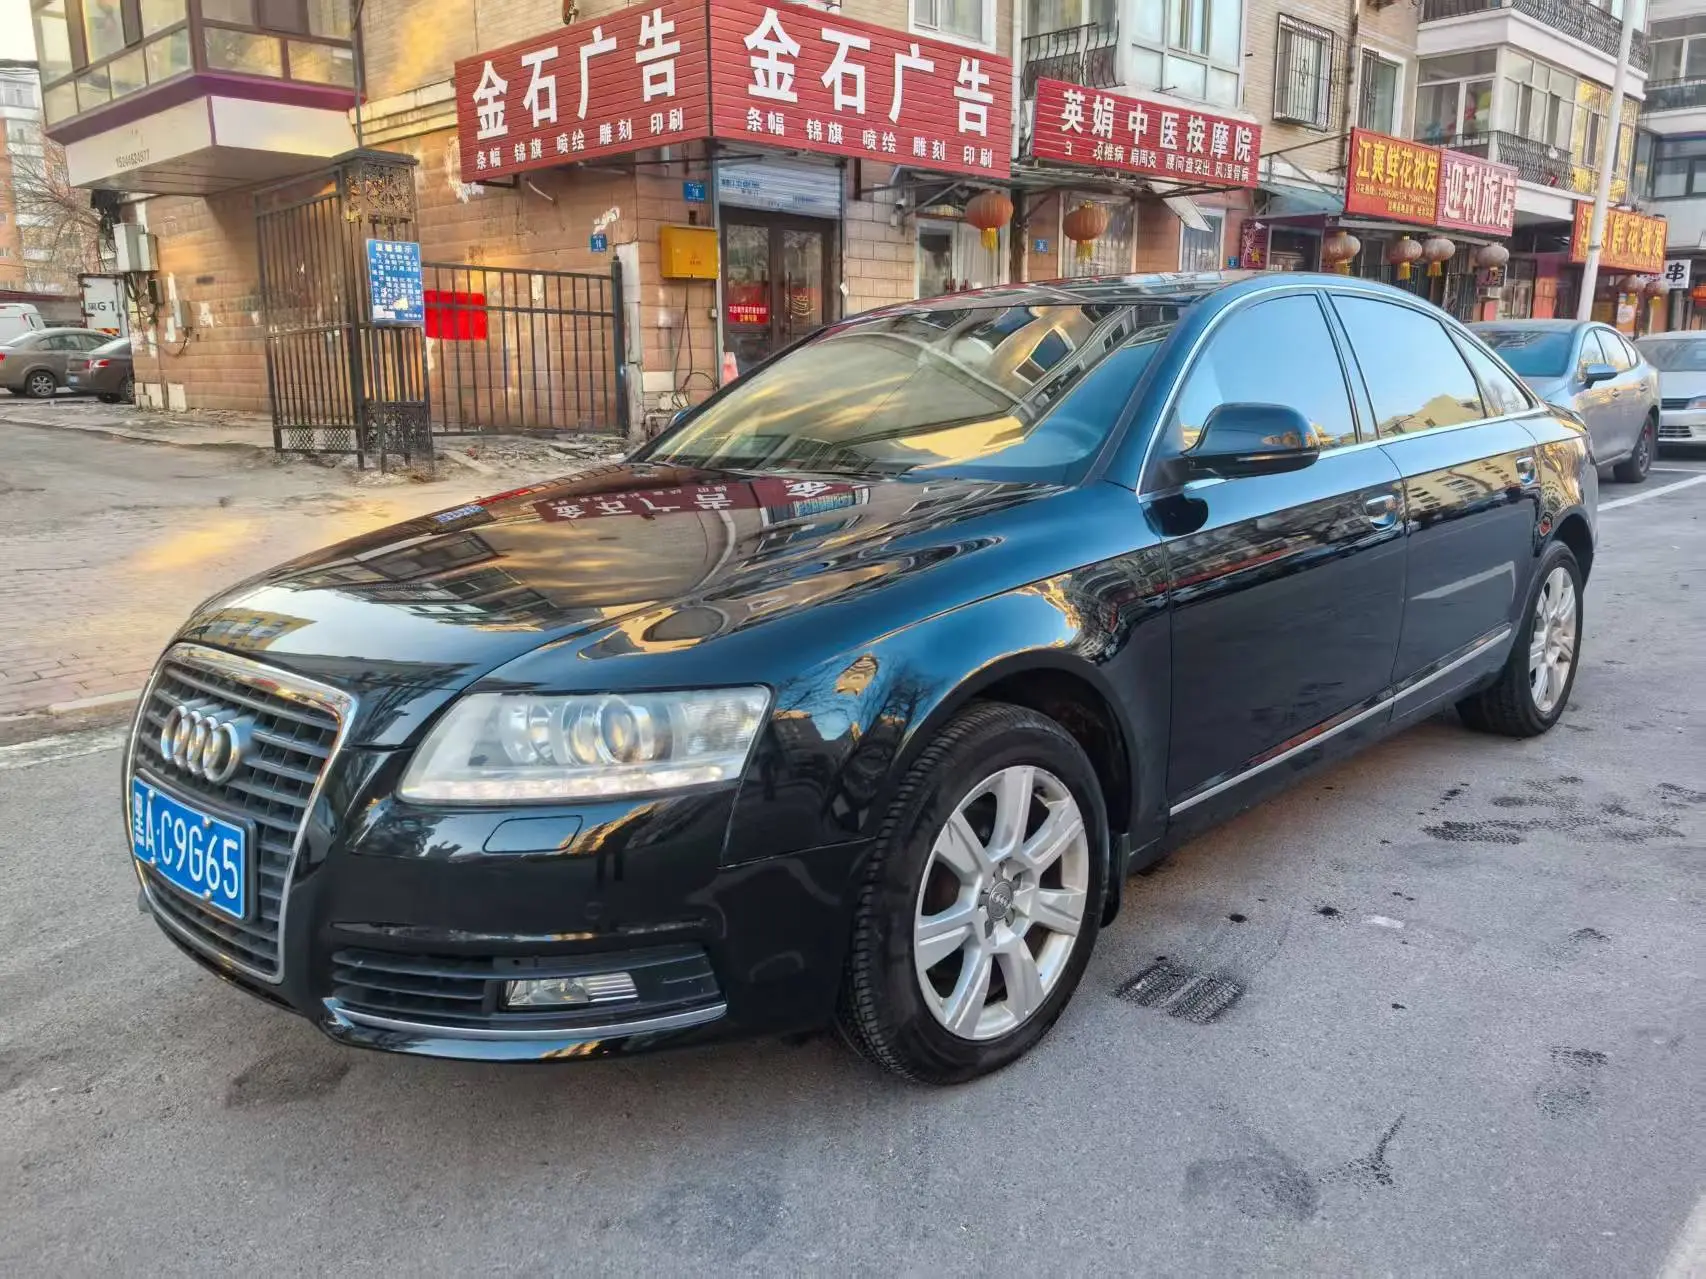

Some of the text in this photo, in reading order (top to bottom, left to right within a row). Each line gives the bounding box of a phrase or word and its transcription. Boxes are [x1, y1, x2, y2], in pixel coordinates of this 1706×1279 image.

[473, 8, 681, 141] 金石广告
[743, 7, 994, 137] 金石广告
[476, 107, 684, 171] 条幅 锦旗 喷绘 雕刻 印刷
[747, 107, 992, 169] 条幅 锦旗 喷绘 雕刻 印刷
[1061, 89, 1253, 162] 英娟中医按摩院
[1165, 153, 1210, 177] 腰间盘突出
[1214, 161, 1249, 183] 风湿骨病
[1443, 161, 1515, 229] 迎利旅店
[1665, 262, 1685, 282] 串
